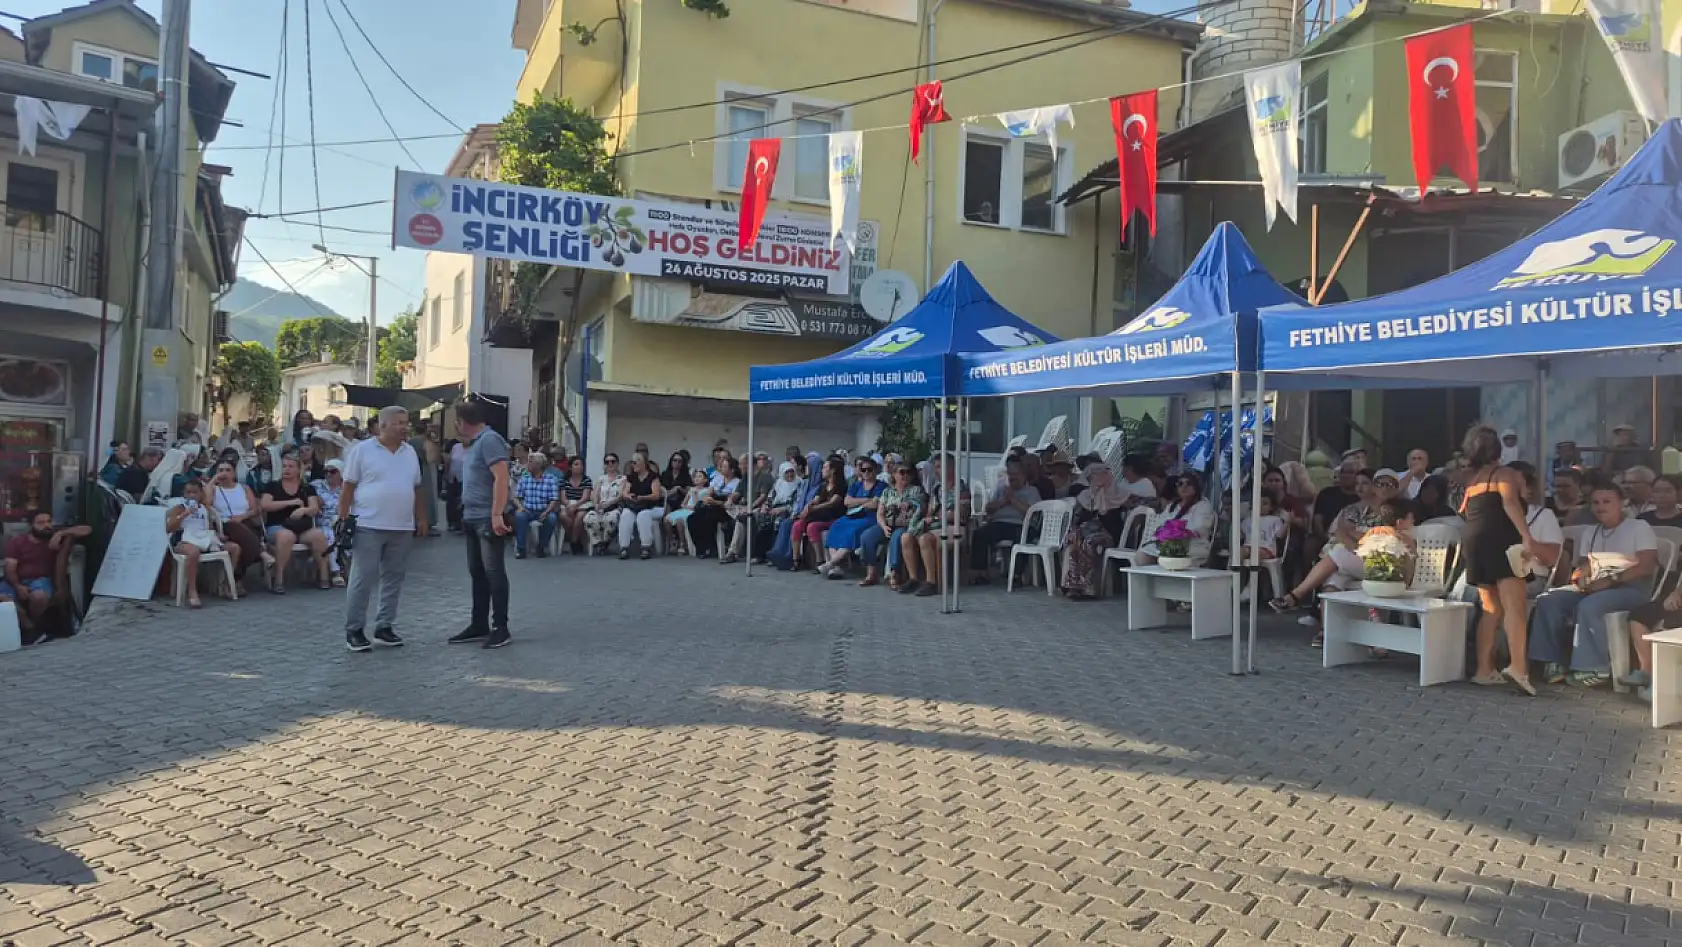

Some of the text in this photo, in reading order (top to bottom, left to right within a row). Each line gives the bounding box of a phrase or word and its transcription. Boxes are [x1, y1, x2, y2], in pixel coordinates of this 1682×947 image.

[452, 184, 604, 227] İNCİRKÖY
[463, 221, 591, 262] ŞENLİĞİ
[648, 229, 710, 258] HOŞ
[665, 263, 824, 289] 24 AĞUSTOS 2025 PAZAR
[803, 304, 848, 318] Mustafa
[1289, 320, 1372, 348] FETHİYE
[1377, 300, 1512, 339] BELEDİYESİ
[1521, 291, 1634, 325] KÜLTÜR
[800, 319, 807, 331] 0
[810, 321, 825, 334] 531
[829, 322, 845, 335] 773
[970, 335, 1208, 380] FETHİYE BELEDİYESİ KÜLTÜR İŞLERİ MÜD.
[761, 370, 928, 391] FETHİYE BELEDİYESİ KÜLTÜR İŞLERİ MÜD.
